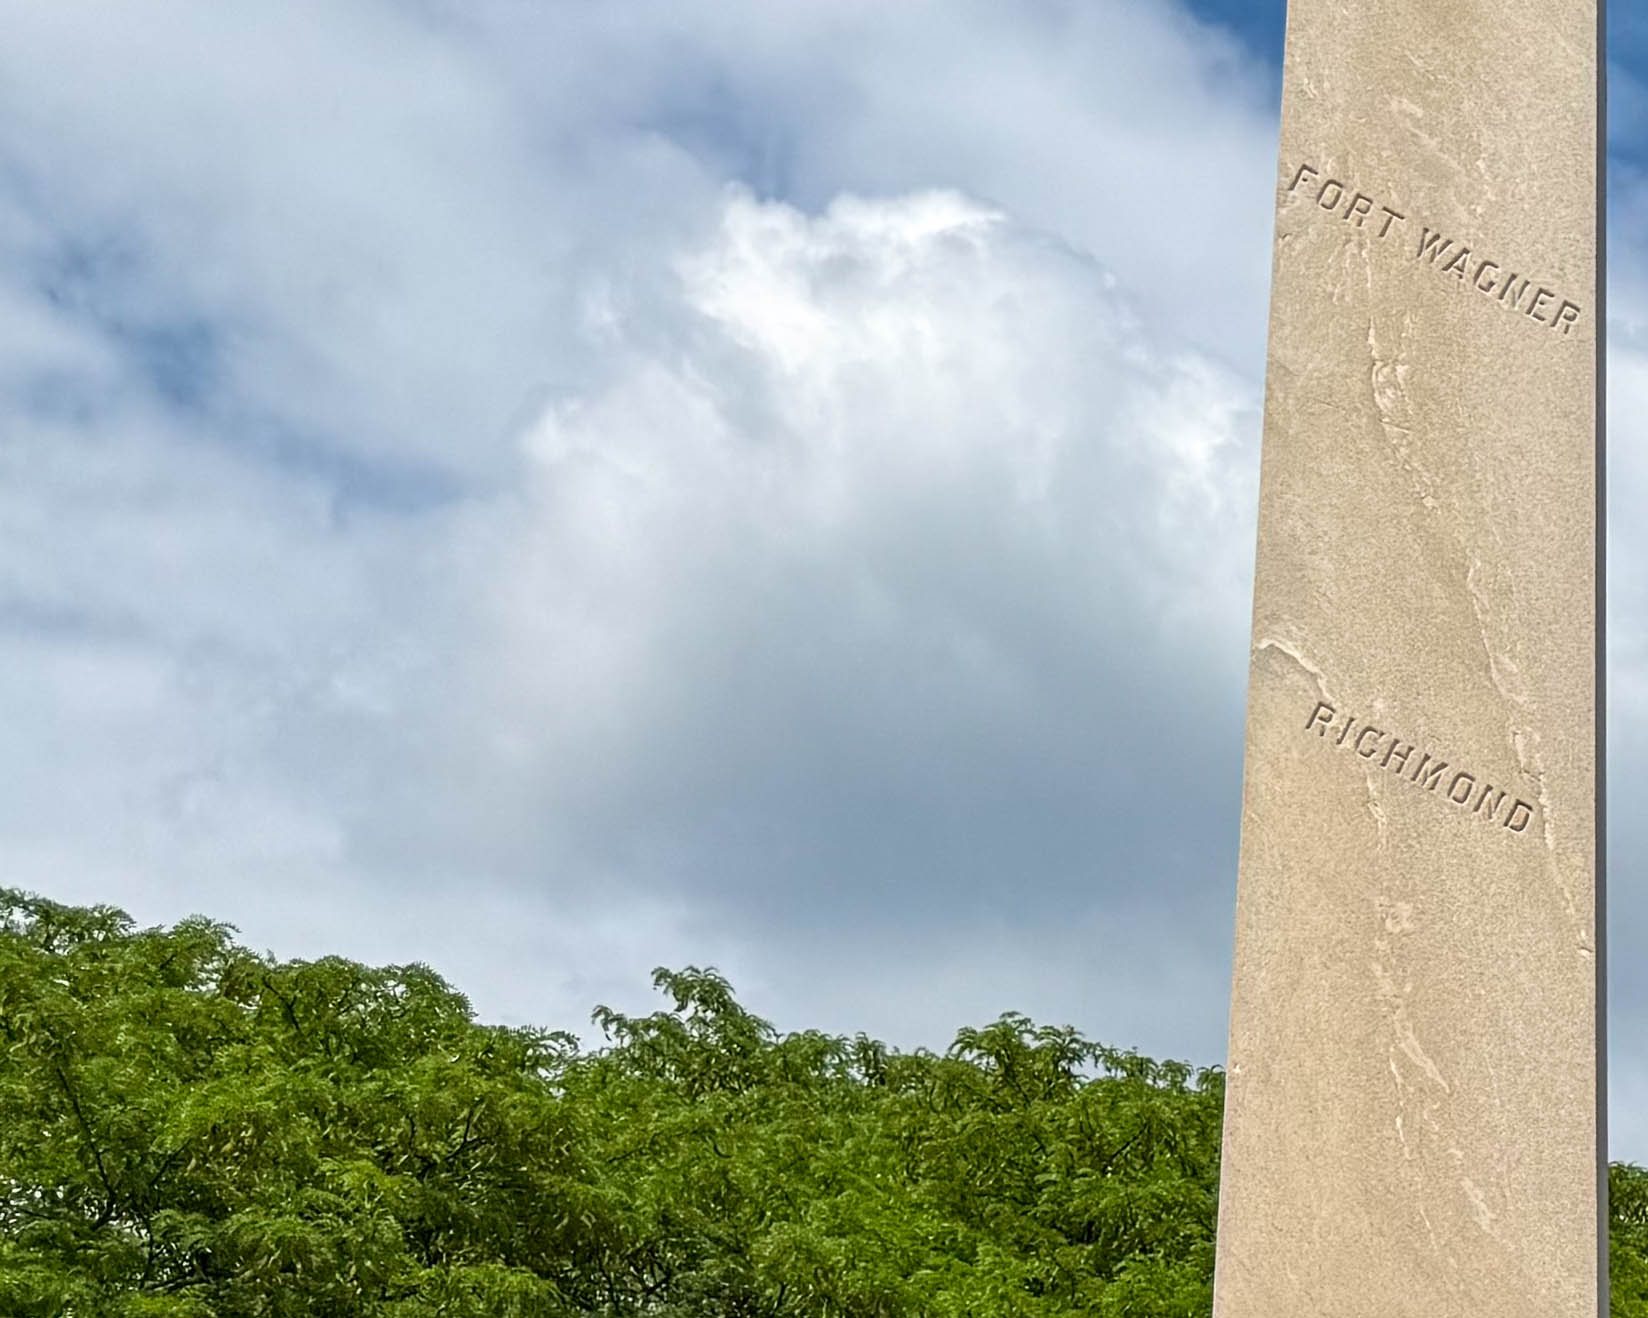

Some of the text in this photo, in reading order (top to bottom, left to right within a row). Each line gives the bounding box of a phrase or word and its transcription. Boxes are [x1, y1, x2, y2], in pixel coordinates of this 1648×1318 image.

[1287, 163, 1582, 336] FORT WAGNER
[1304, 700, 1536, 834] RICHMOND
